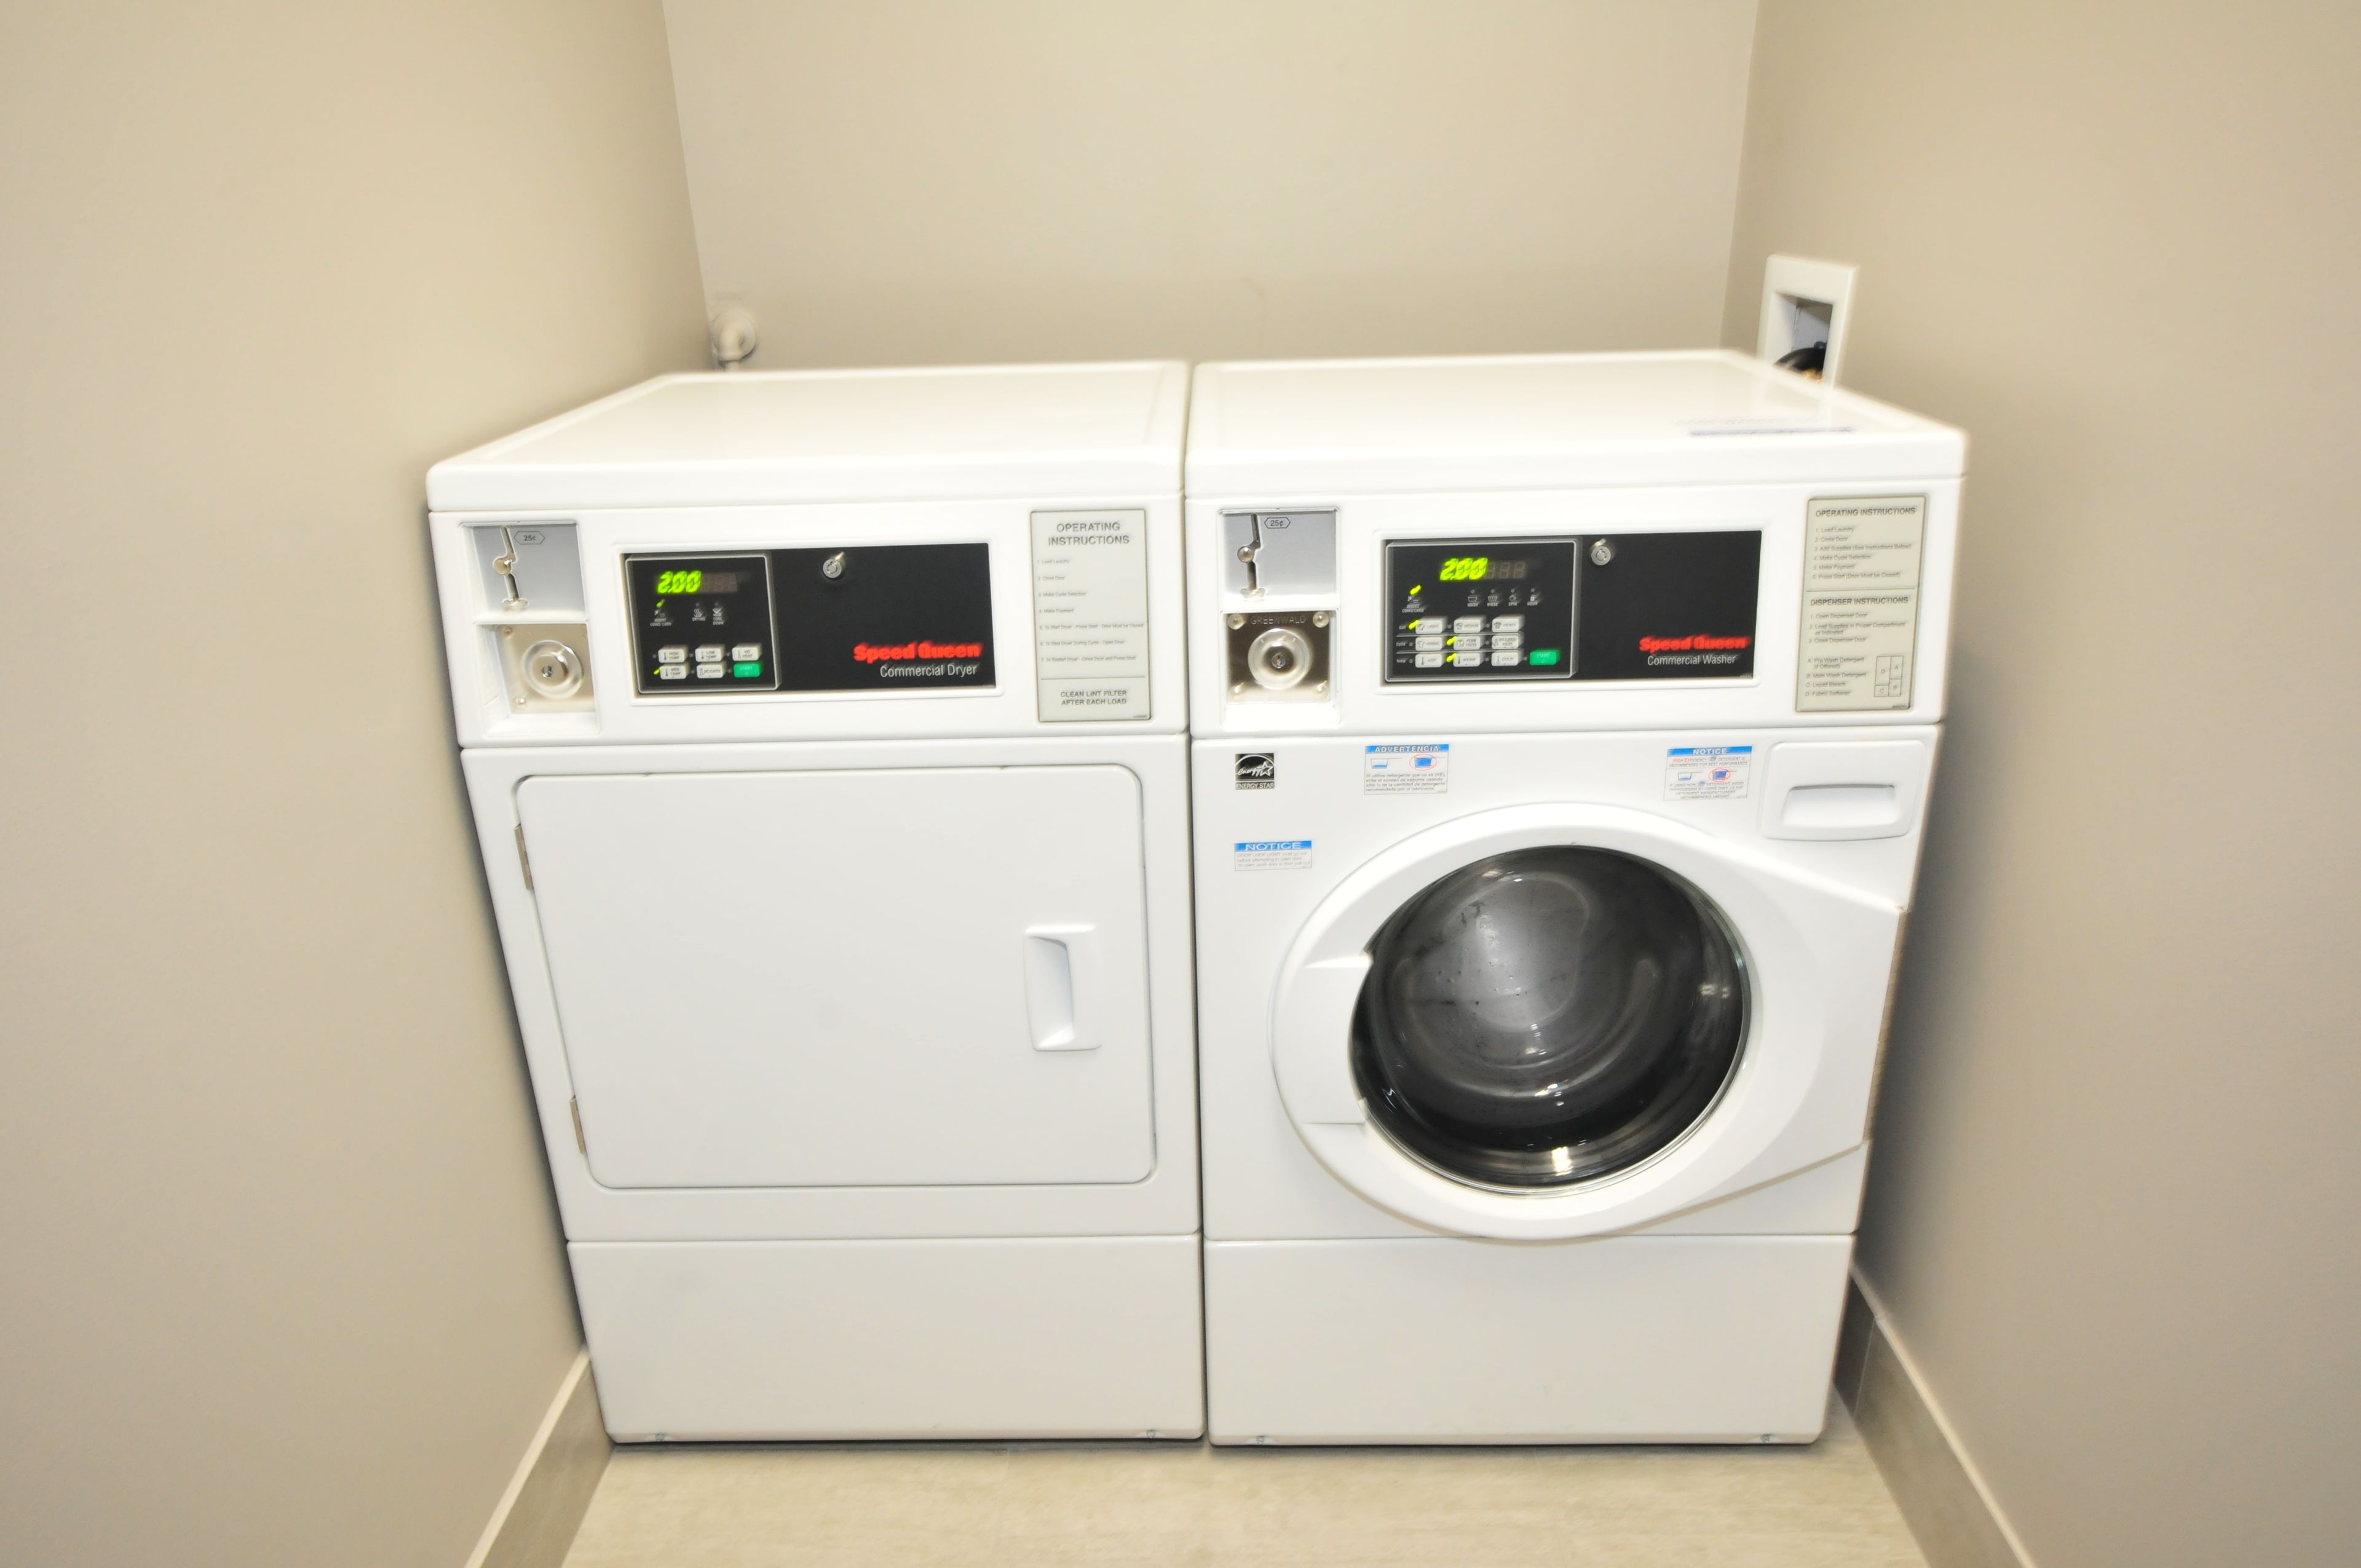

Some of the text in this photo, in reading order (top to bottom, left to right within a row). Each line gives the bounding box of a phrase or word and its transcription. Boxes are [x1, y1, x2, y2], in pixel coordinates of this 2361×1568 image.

[1057, 522, 1120, 532] OPERATING
[1048, 535, 1129, 545] INSTRUCTIONS
[1251, 616, 1305, 624] GREENWALD
[1640, 635, 1748, 653] Speed Queen
[854, 641, 982, 663] Speed Queen
[1648, 655, 1736, 665] Commercial Washer
[880, 664, 978, 678] Commercial Dryer
